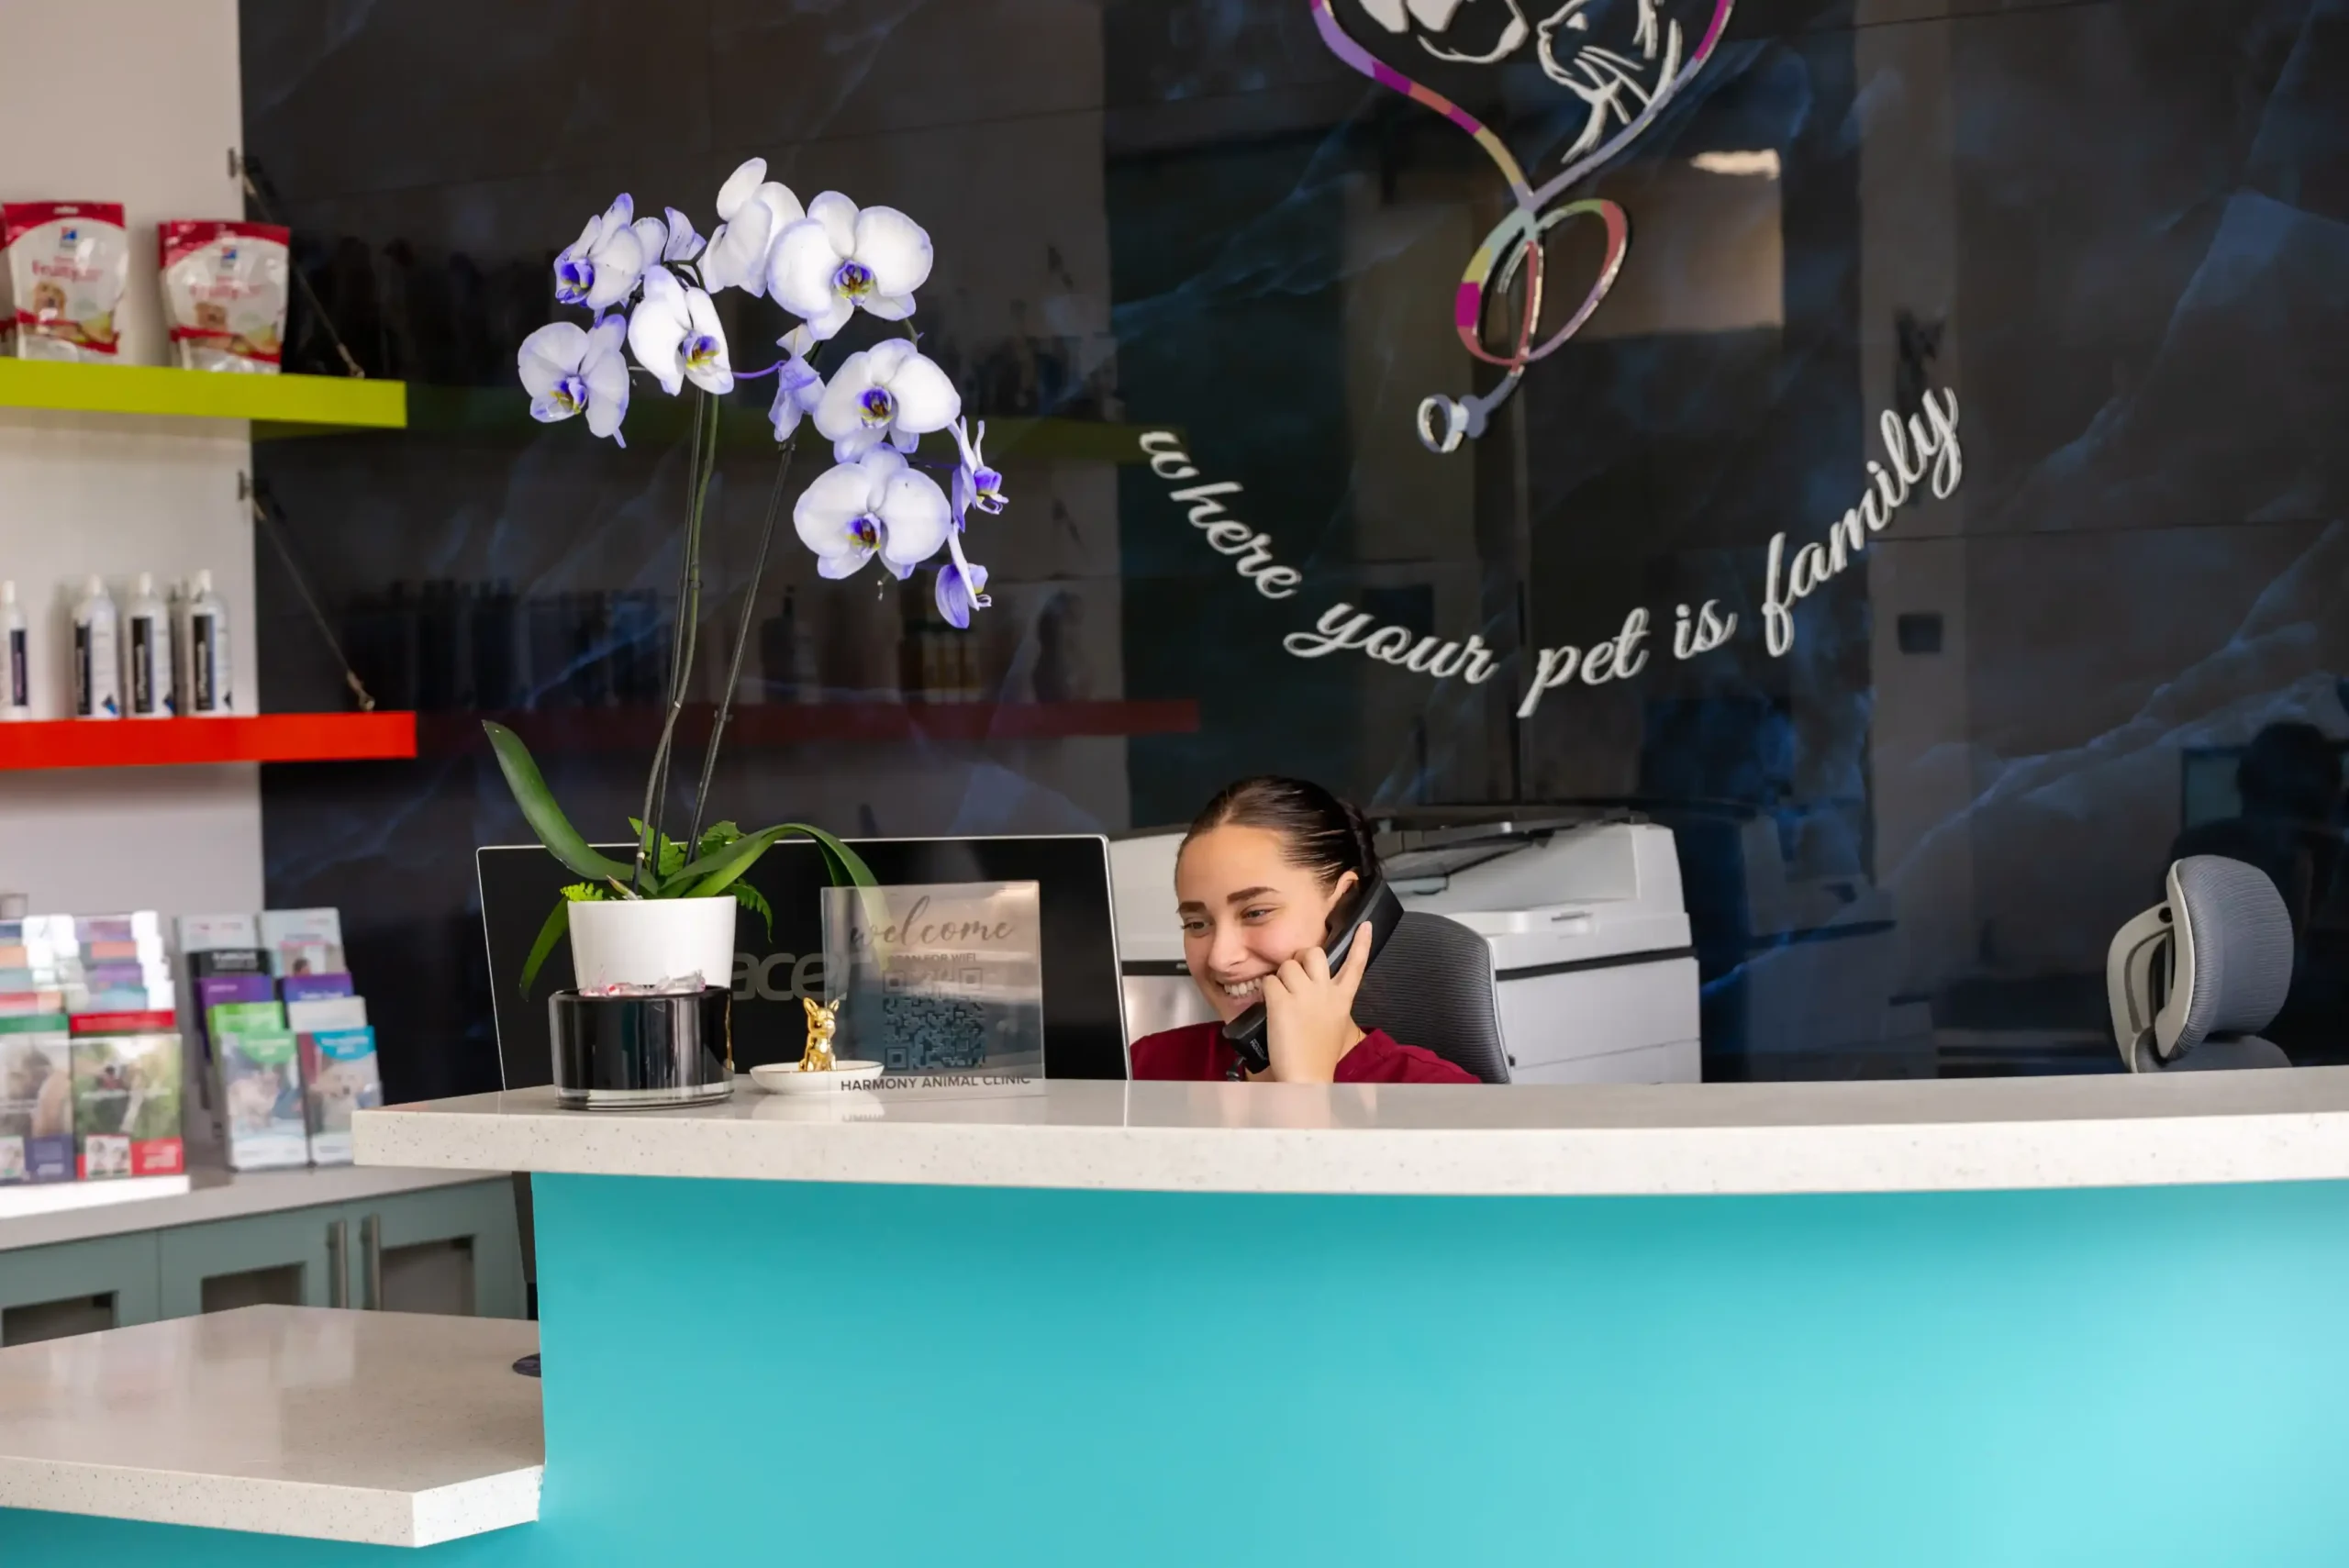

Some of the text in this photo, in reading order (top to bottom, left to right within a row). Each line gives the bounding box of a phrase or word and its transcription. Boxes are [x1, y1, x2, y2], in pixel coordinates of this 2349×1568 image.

[1139, 387, 1962, 717] where your pet is family
[851, 895, 1015, 946] welcome
[841, 1075, 1031, 1091] HARMONY ANIMAL CLINIC
